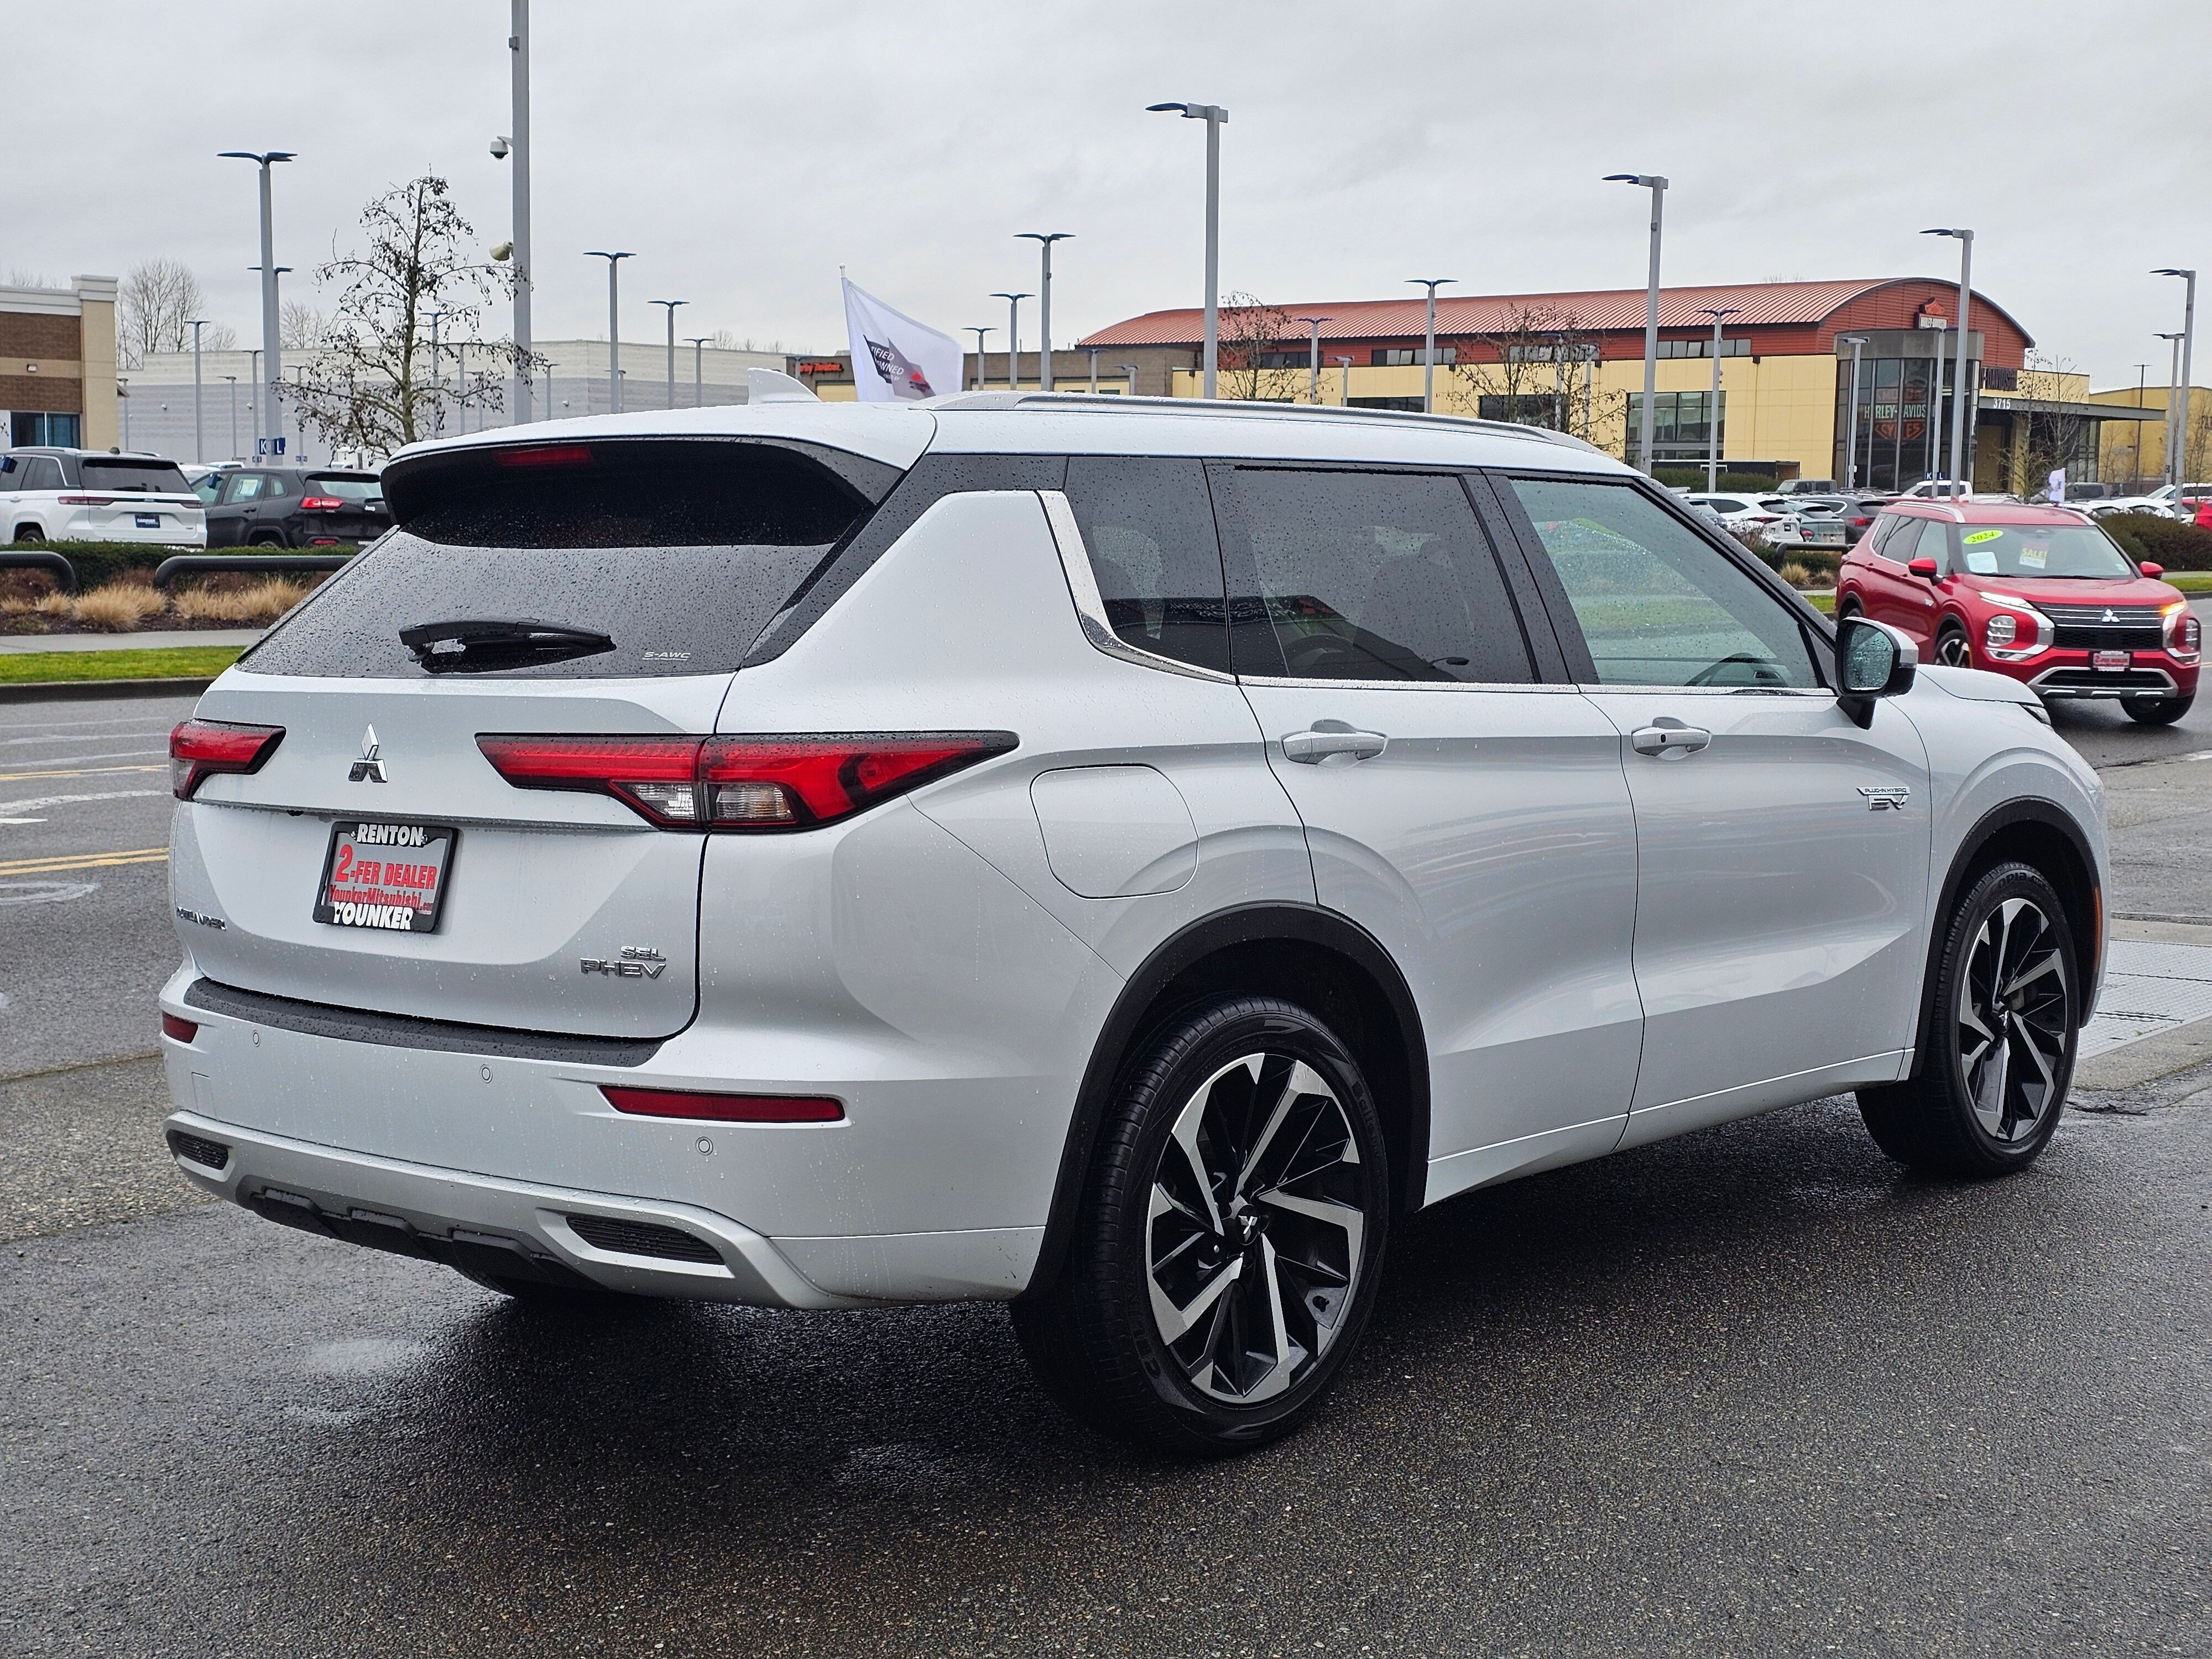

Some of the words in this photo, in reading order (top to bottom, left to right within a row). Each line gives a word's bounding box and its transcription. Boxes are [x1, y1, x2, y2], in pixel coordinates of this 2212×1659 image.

[1994, 398, 2011, 409] 3715
[260, 440, 267, 453] K
[277, 440, 282, 453] L
[1868, 795, 1908, 811] EV
[357, 823, 424, 846] RENTON
[335, 844, 382, 885] 2-FER
[383, 863, 437, 890] DEALER
[333, 901, 414, 930] YOUNKER
[620, 946, 666, 962] SEL
[580, 957, 666, 979] PHEV
